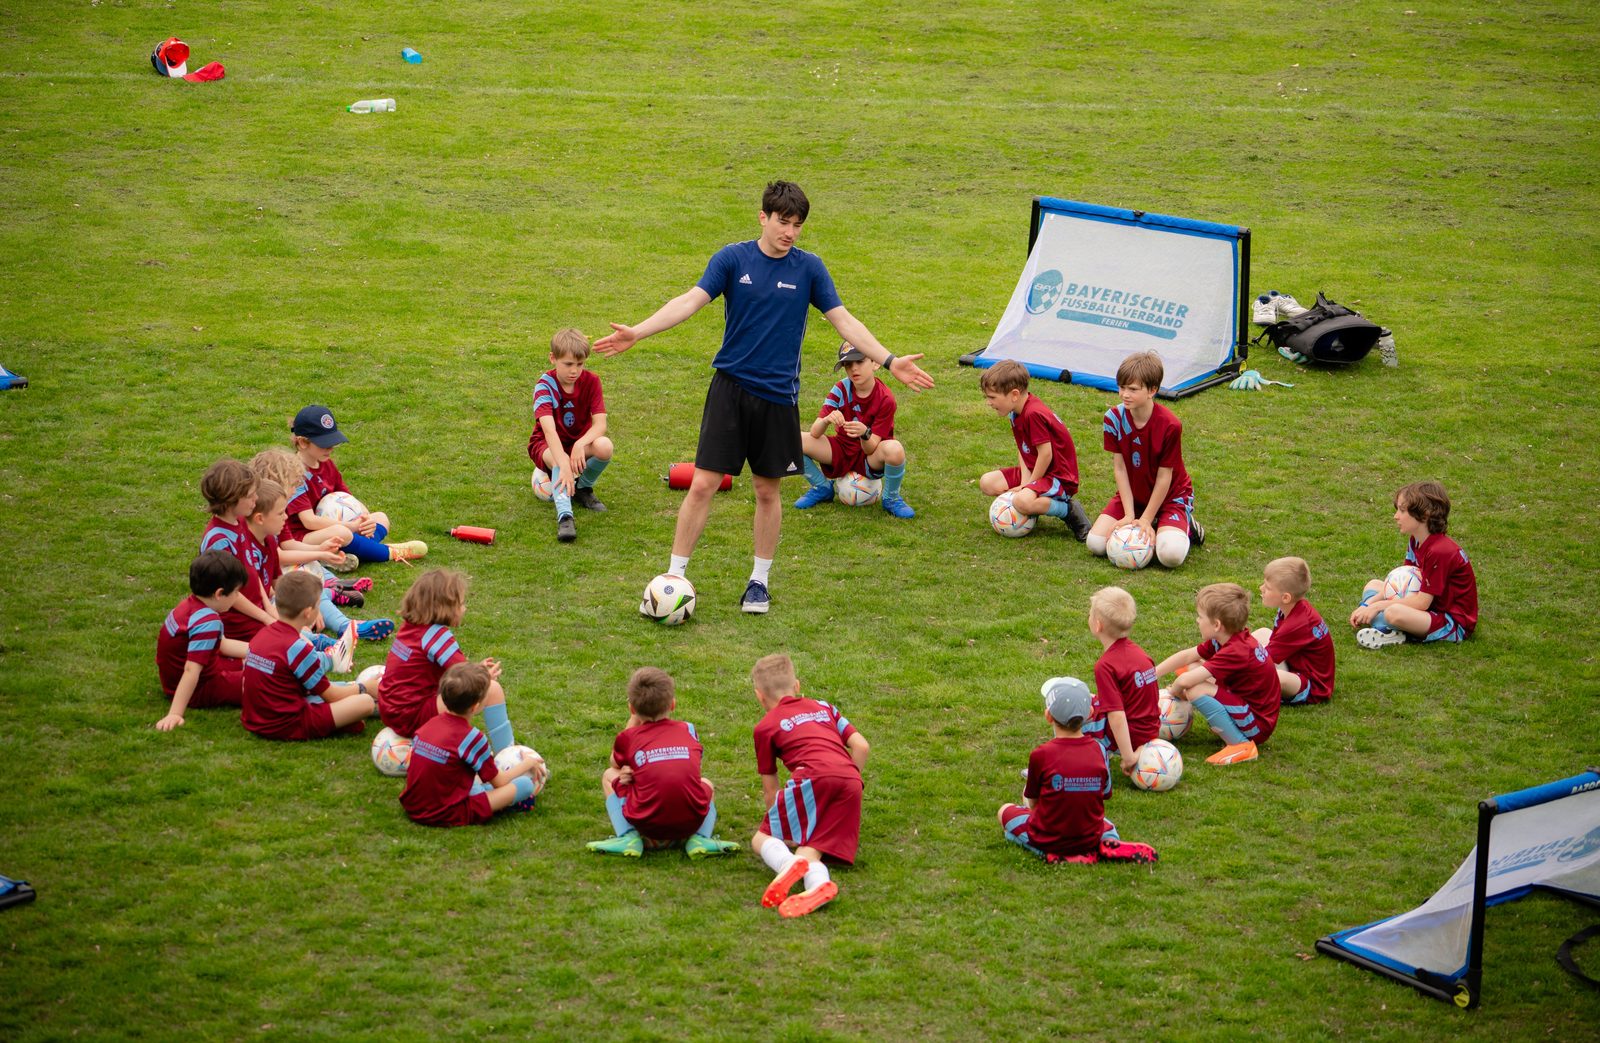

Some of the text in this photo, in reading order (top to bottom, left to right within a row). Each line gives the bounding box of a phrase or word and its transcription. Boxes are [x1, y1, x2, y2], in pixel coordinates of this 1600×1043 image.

[1060, 297, 1184, 328] FUSSBALL-VERBAND
[1066, 283, 1190, 317] BAYERISCHER
[1101, 317, 1130, 328] FERIEN
